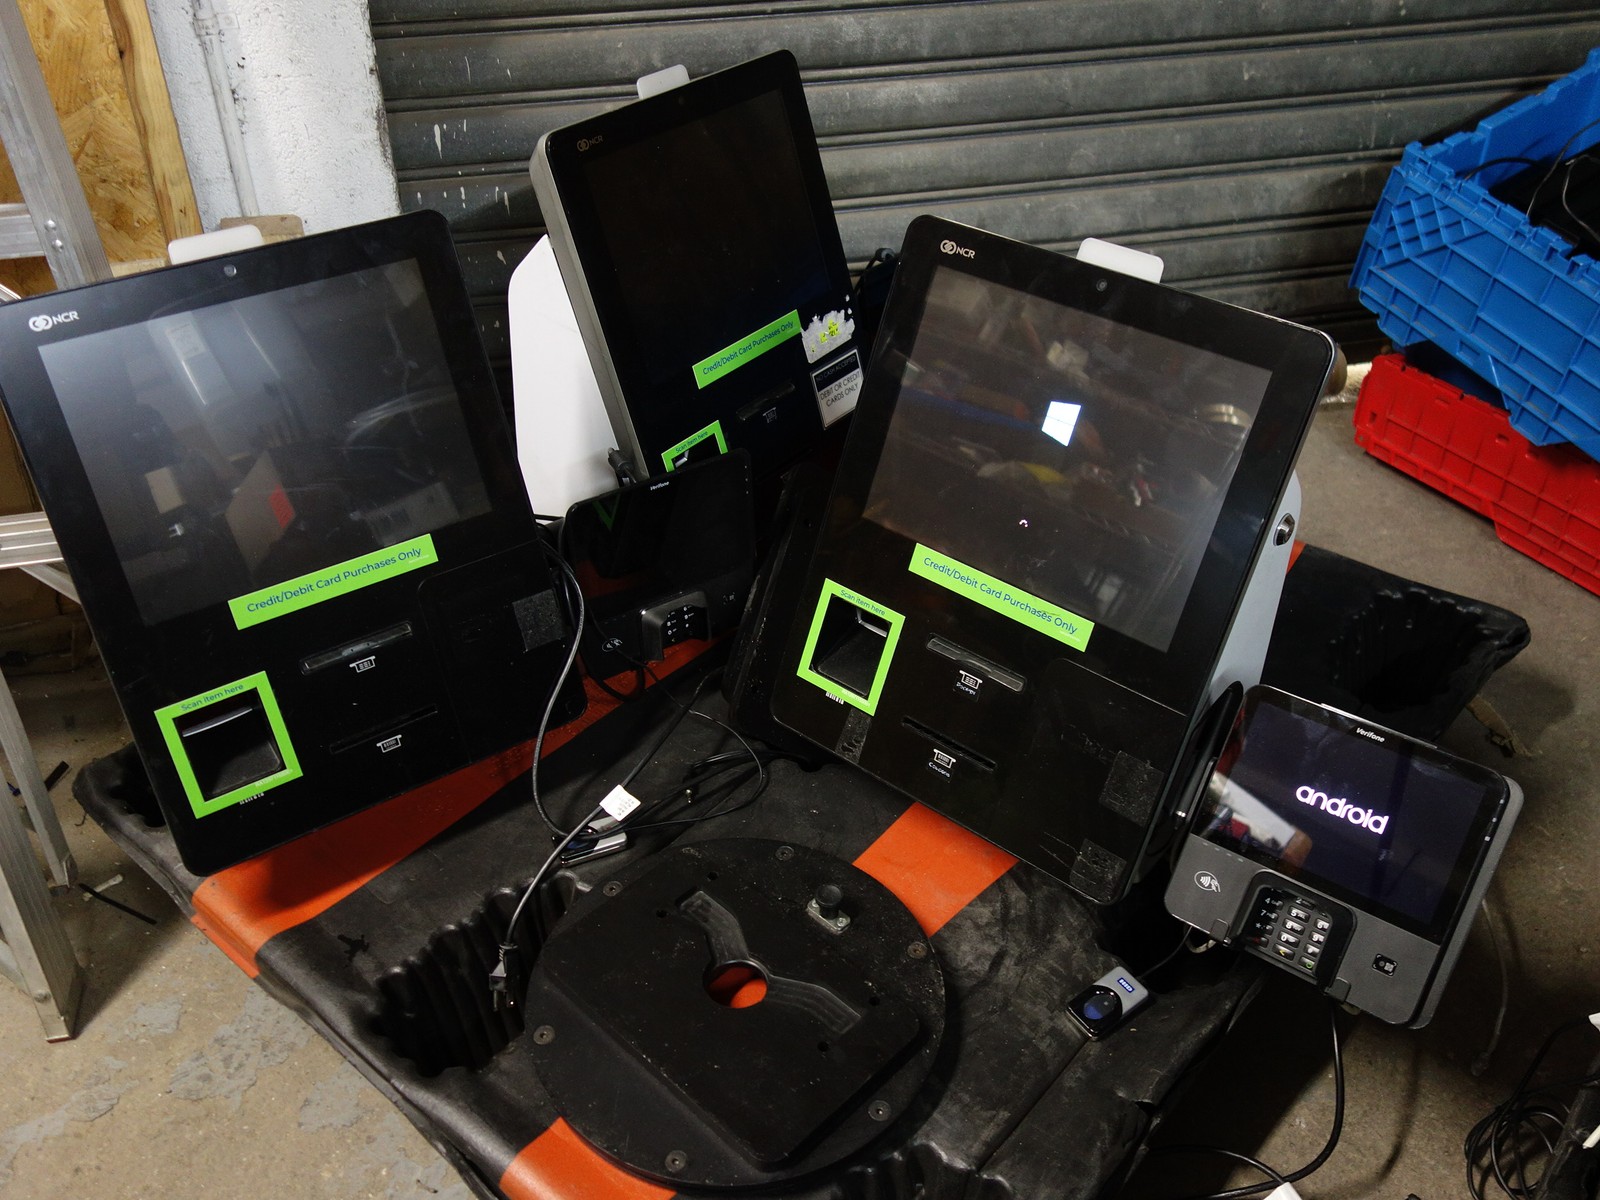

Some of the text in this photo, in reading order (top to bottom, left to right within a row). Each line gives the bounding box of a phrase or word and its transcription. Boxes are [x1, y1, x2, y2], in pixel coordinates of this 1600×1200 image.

[589, 135, 603, 146] NCR
[956, 246, 976, 259] NCR
[52, 311, 80, 325] NCR
[703, 351, 738, 375] Credit/Debit
[738, 343, 752, 355] Card
[752, 329, 781, 348] Purchases
[780, 321, 794, 333] Only
[820, 371, 860, 400] DEBIT OR CREDIT
[826, 383, 859, 407] CARDS ONLY
[675, 443, 687, 453] Scan
[246, 584, 315, 613] Credit/Debit
[315, 574, 342, 590] Card
[343, 556, 397, 580] Purchases
[397, 547, 422, 561] Only
[840, 589, 886, 616] Scan item here
[923, 557, 1078, 635] Credit/Debit Card Purchases Only
[180, 684, 244, 711] Scan item here
[1356, 727, 1385, 743] Verifone
[1295, 785, 1390, 835] android
